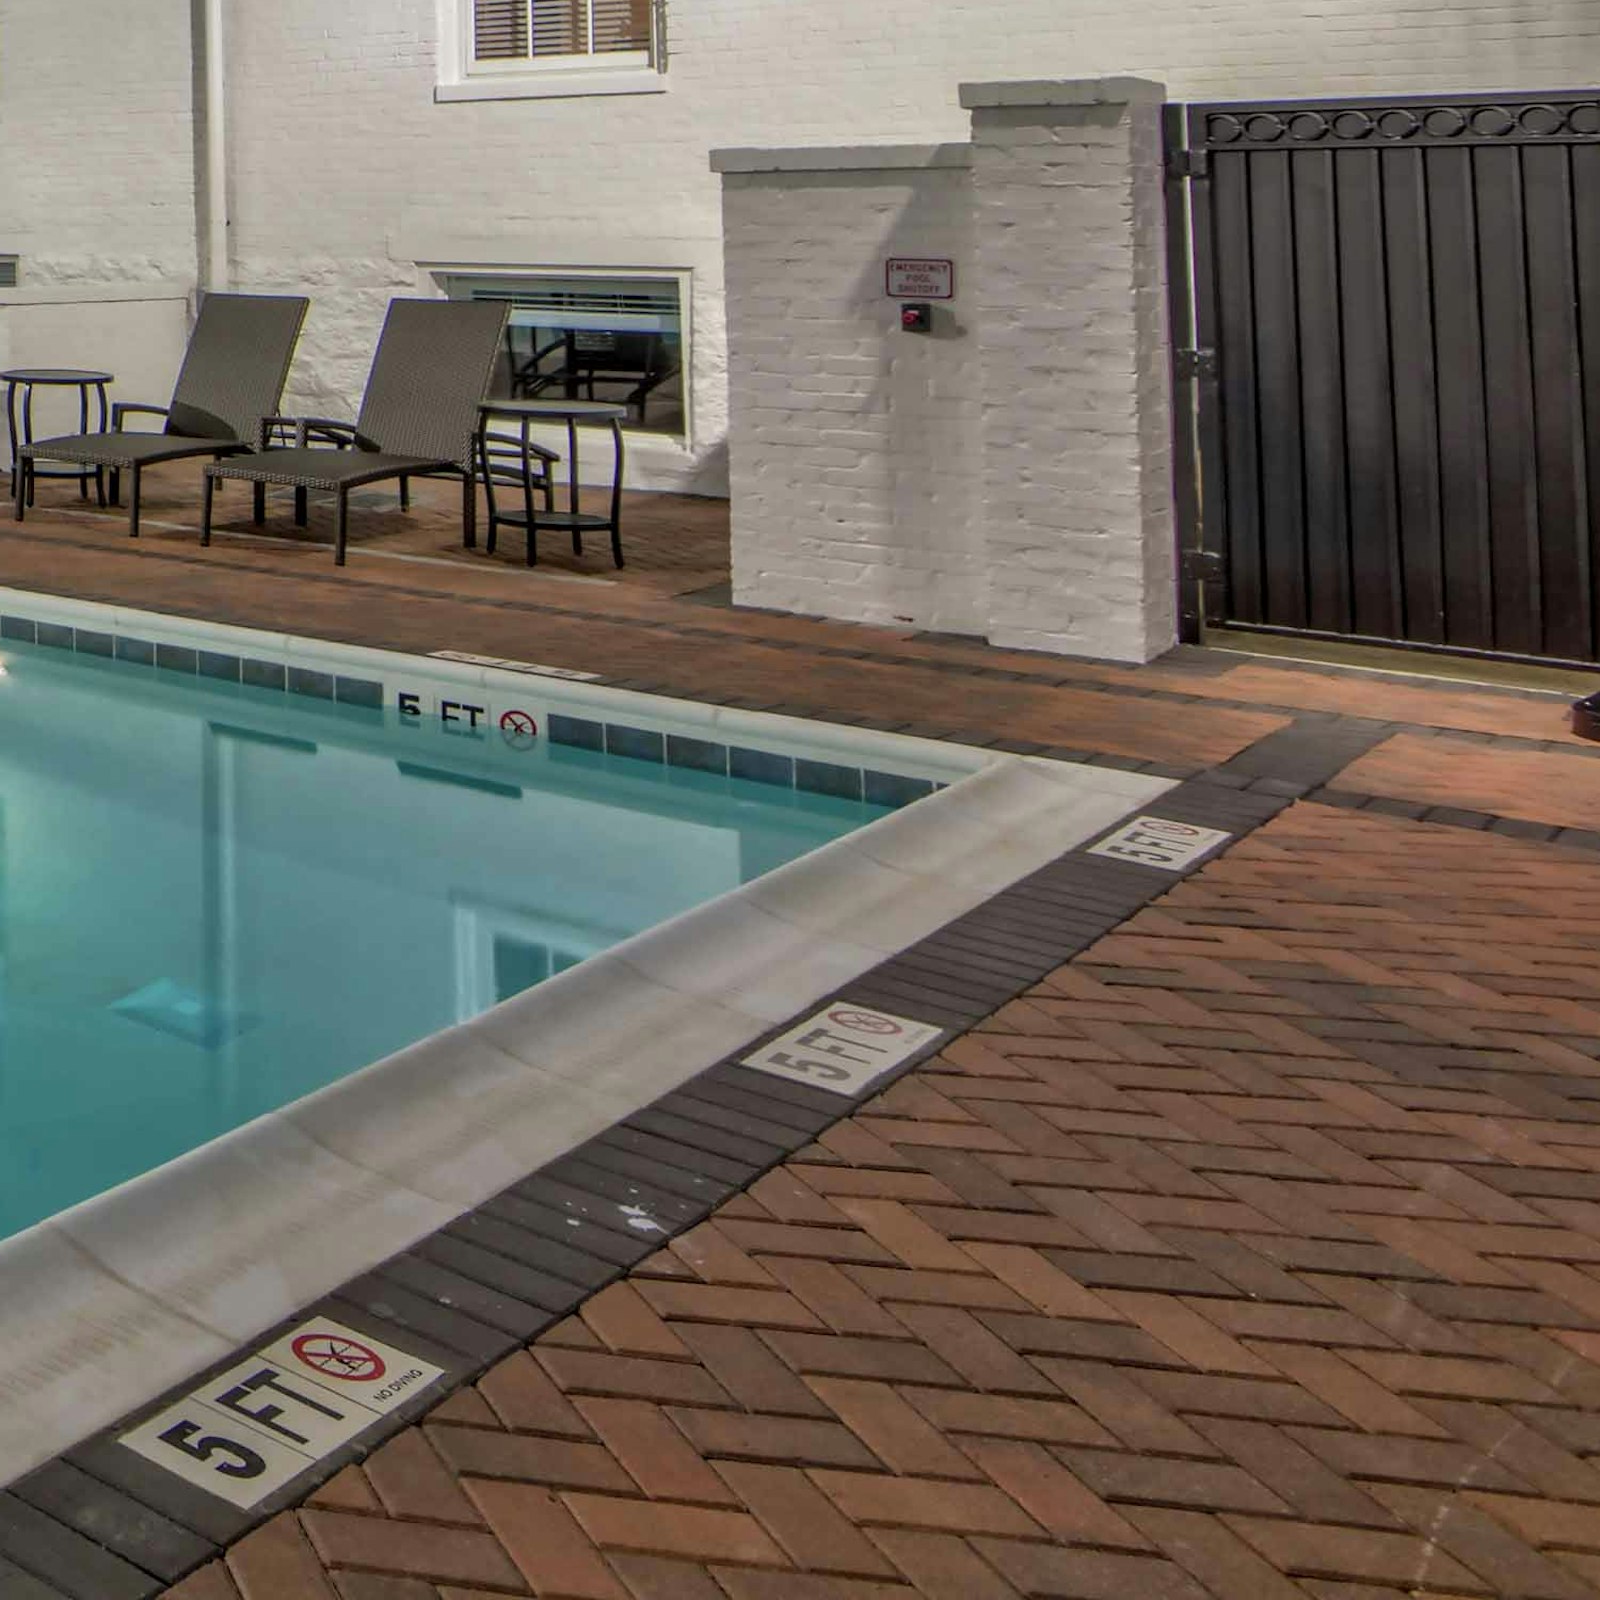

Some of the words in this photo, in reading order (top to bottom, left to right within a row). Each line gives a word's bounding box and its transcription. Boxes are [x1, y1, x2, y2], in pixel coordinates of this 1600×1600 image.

[441, 700, 485, 728] FT
[1105, 845, 1173, 863] 5
[1122, 831, 1196, 854] FT
[794, 1027, 889, 1065] FT
[767, 1051, 851, 1081] 5
[373, 1389, 393, 1403] NO
[388, 1369, 423, 1391] DIVING
[157, 1419, 267, 1479] 5
[214, 1367, 346, 1445] FT
